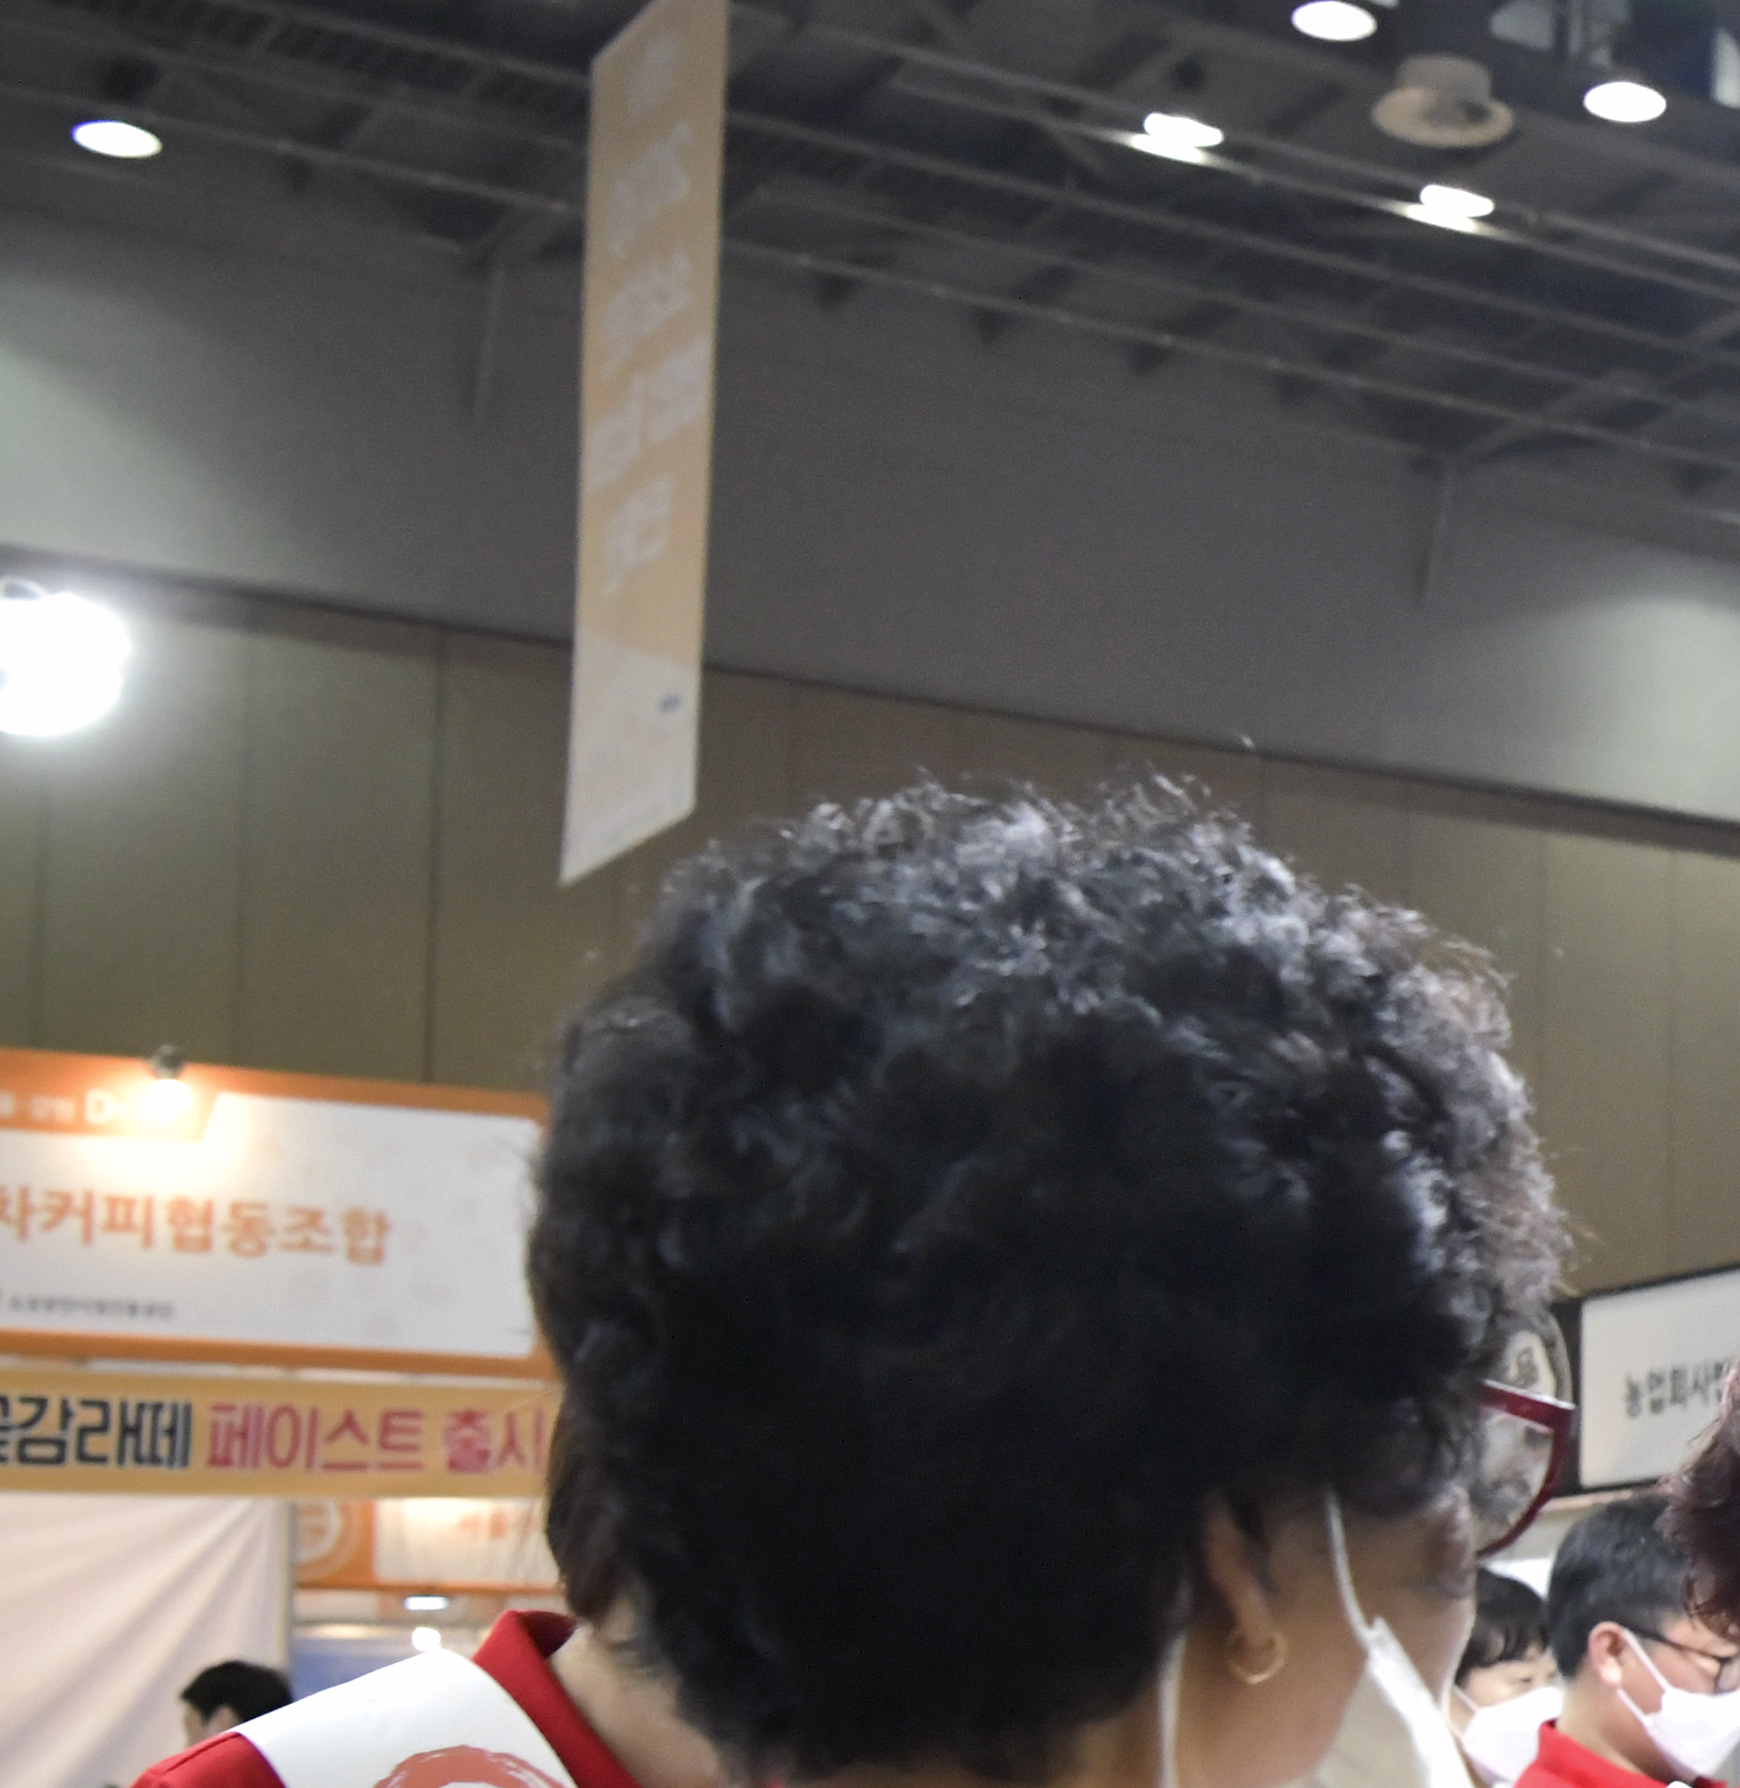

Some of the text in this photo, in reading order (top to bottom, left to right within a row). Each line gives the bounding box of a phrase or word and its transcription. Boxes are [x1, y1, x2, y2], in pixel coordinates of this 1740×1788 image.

[0, 1395, 546, 1475] 감라떼 페이스트 출시
